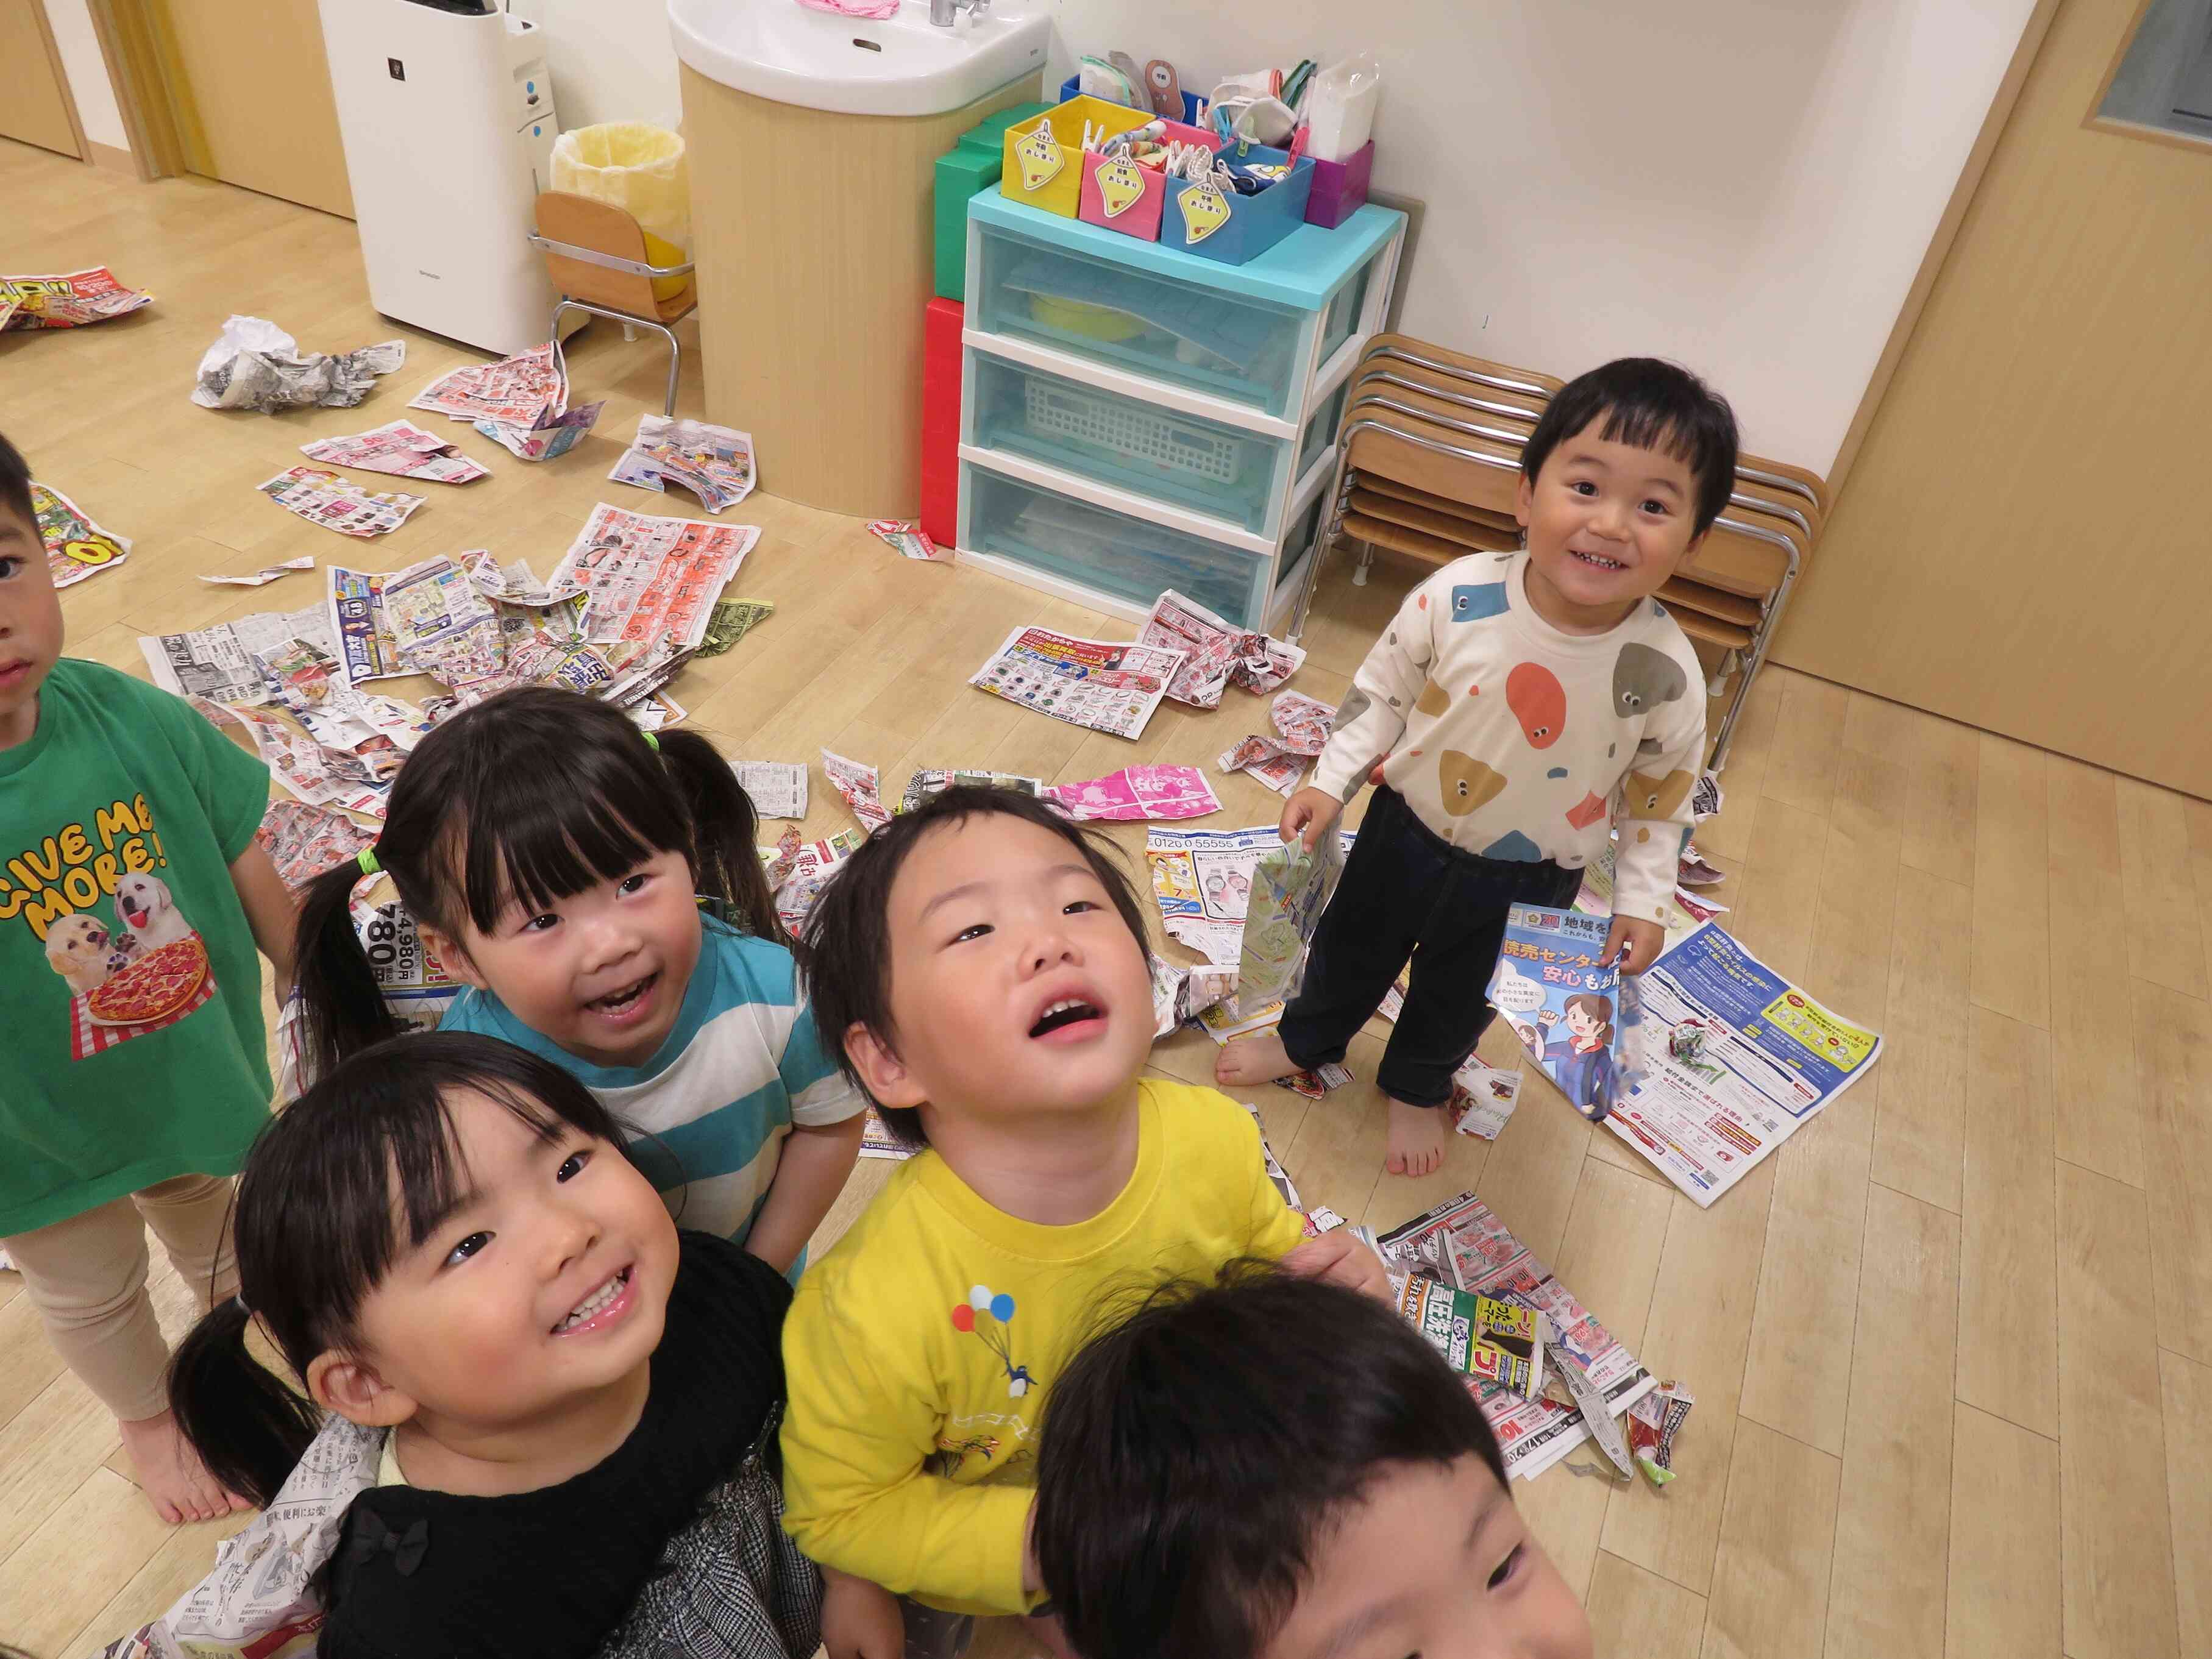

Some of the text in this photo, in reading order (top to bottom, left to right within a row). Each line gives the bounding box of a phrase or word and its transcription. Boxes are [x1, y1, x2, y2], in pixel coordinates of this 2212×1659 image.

[1026, 149, 1054, 163] おしぼり
[1109, 176, 1137, 189] おしぼり
[1191, 201, 1220, 215] おしぼり
[95, 792, 153, 851] ME
[1154, 837, 1181, 848] 0120
[1195, 839, 1234, 848] 55555
[25, 831, 167, 943] MORE!
